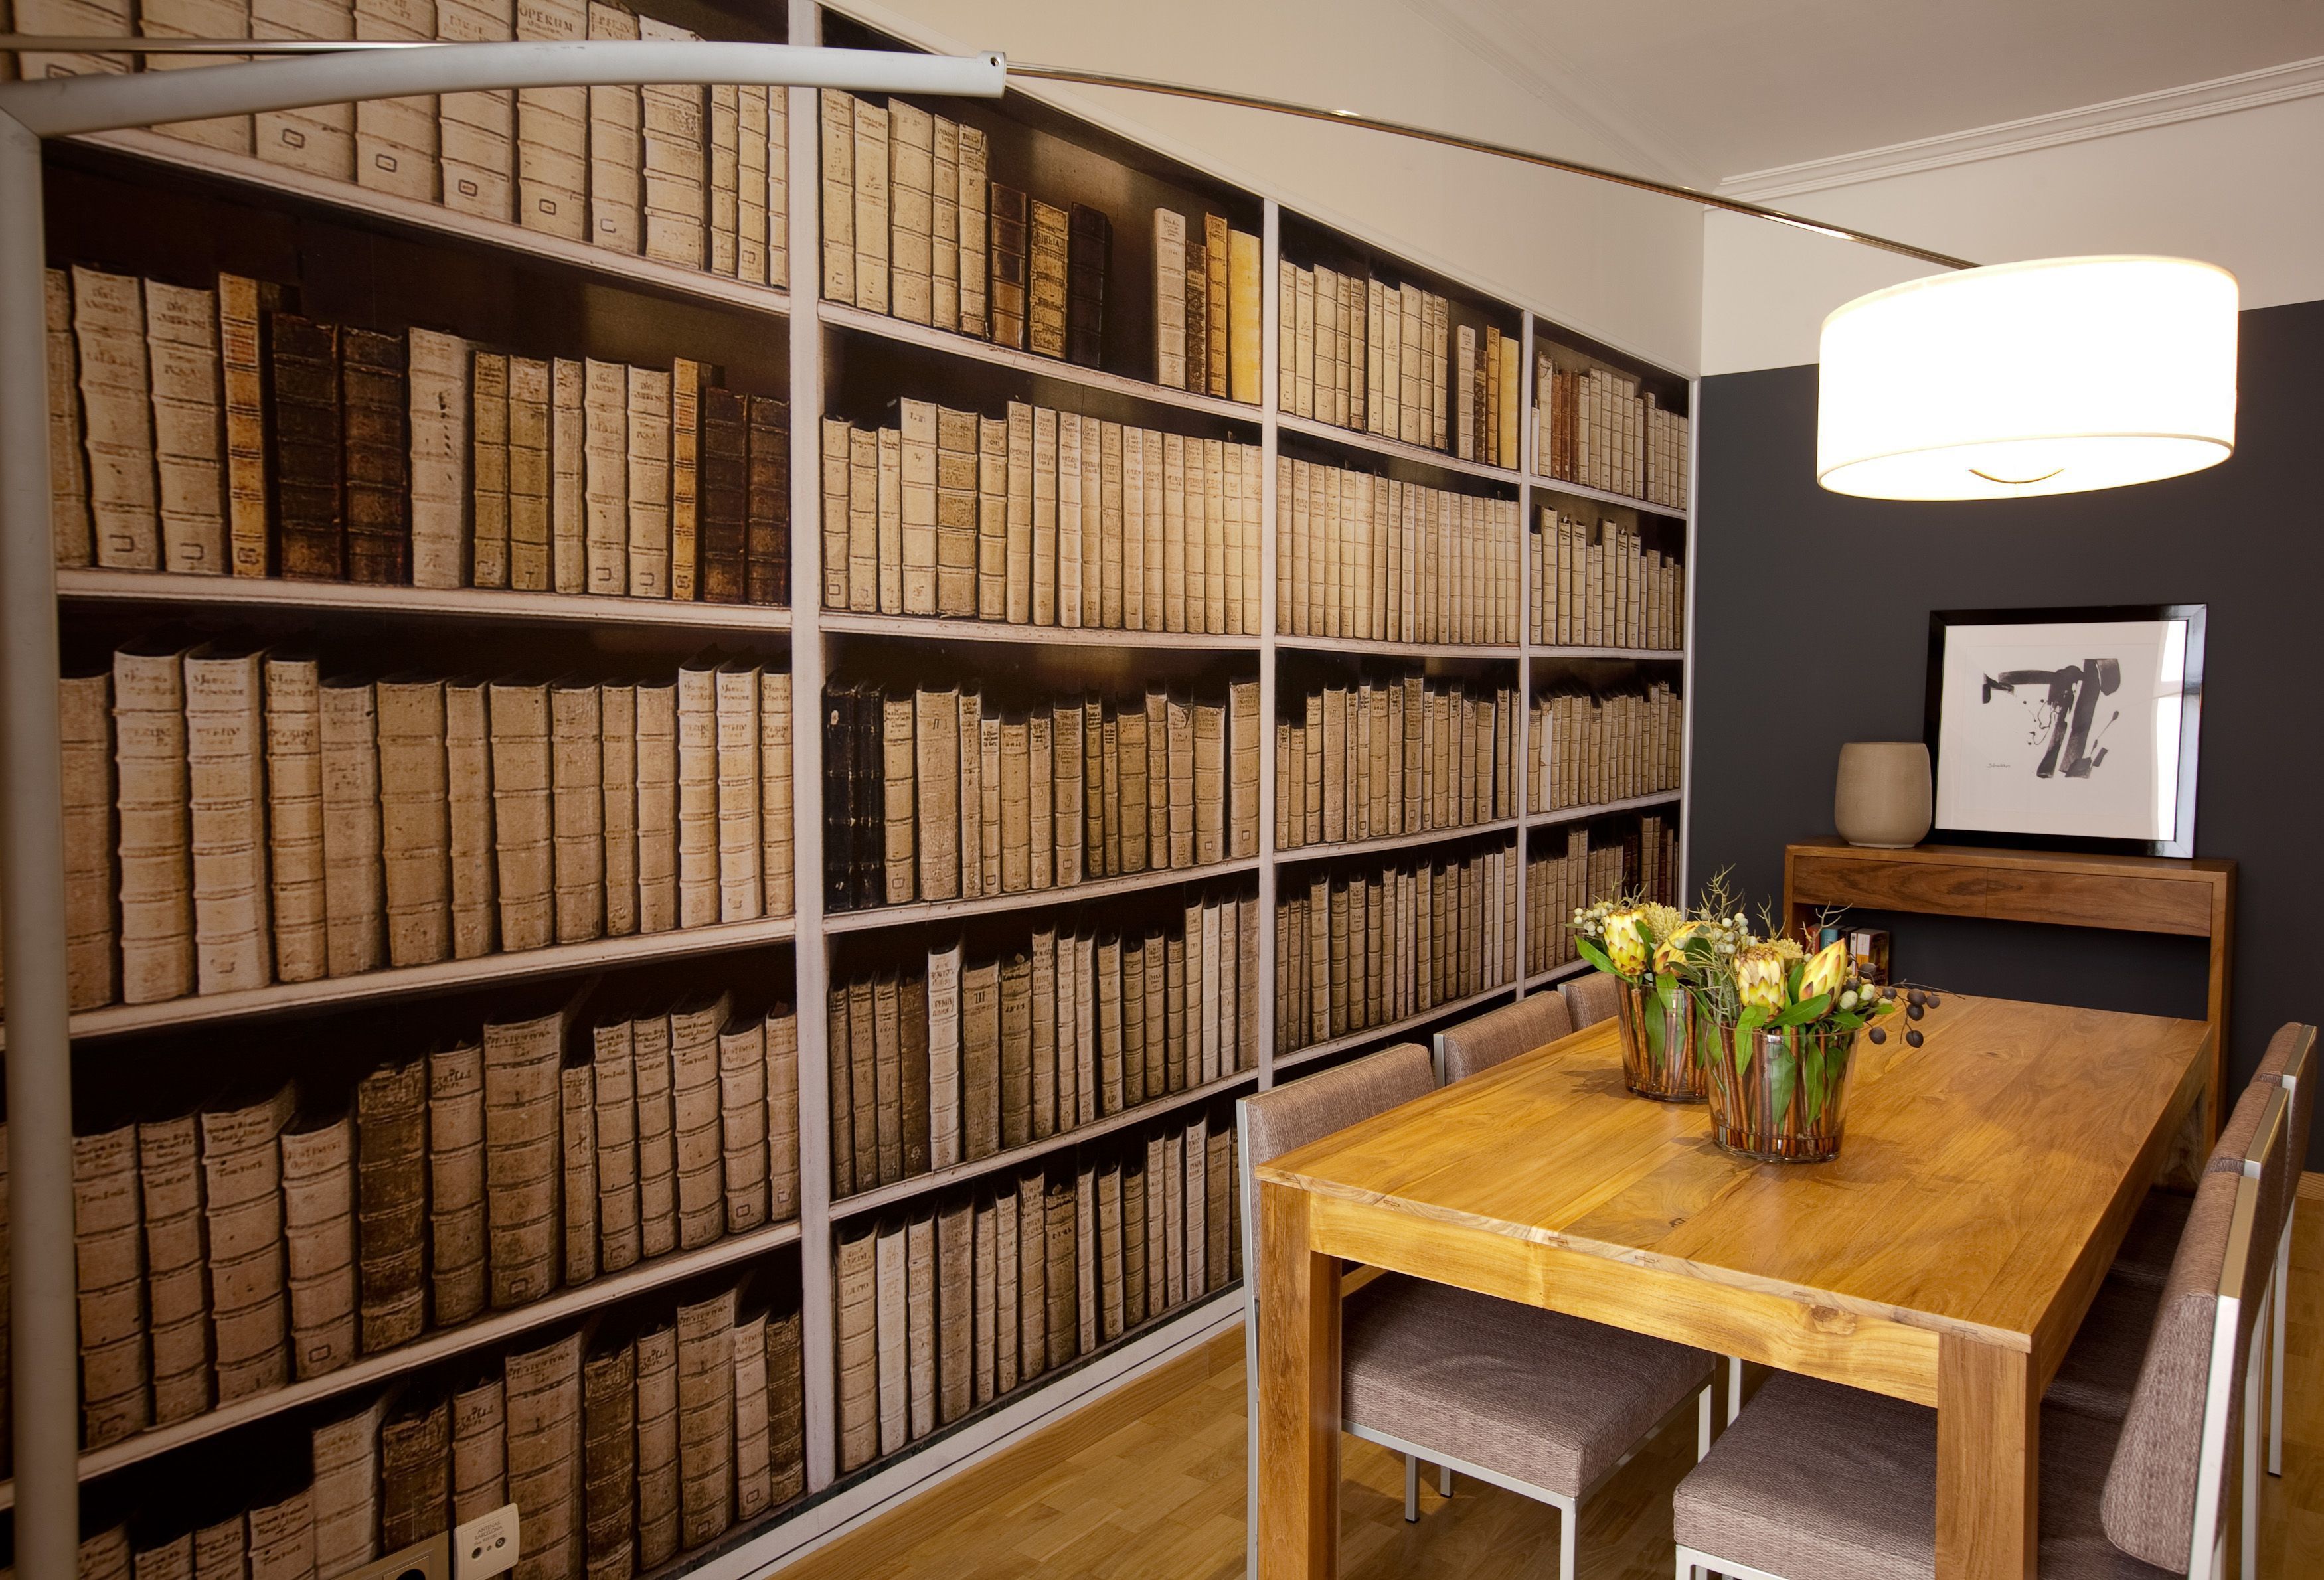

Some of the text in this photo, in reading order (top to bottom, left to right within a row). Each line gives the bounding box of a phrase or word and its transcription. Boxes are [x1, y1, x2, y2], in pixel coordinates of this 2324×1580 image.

[519, 6, 573, 32] OPERUM
[1037, 230, 1060, 248] BIBLIA
[475, 1525, 503, 1540] BARCELONA
[477, 1520, 501, 1534] ANTENAS
